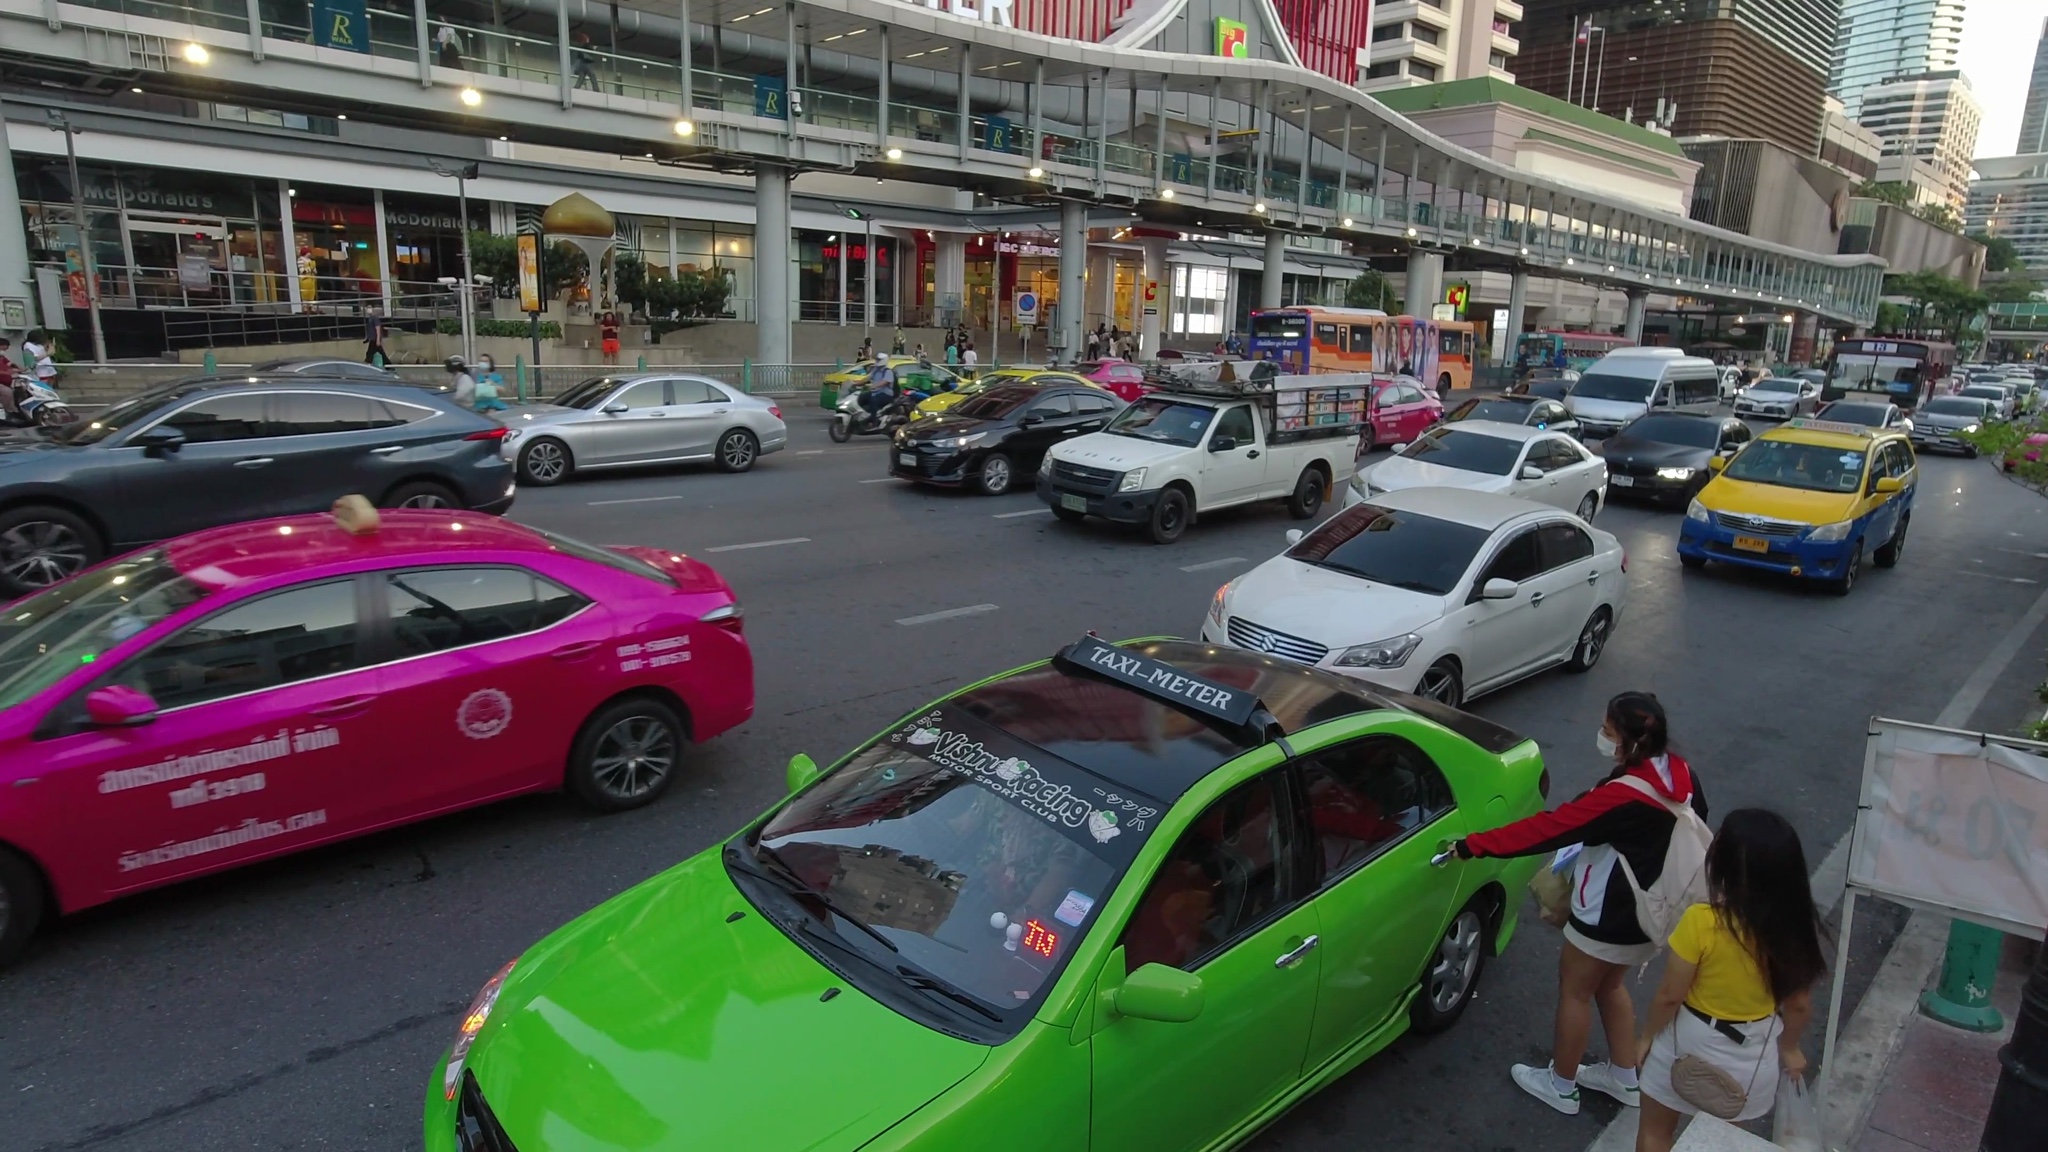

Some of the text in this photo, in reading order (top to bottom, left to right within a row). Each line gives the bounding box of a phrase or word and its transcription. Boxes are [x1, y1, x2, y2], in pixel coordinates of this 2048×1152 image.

[333, 14, 350, 38] R
[1221, 24, 1235, 40] Big
[1090, 646, 1232, 711] TAXI-METER
[928, 753, 1058, 823] MOTOR SPORT CLUB
